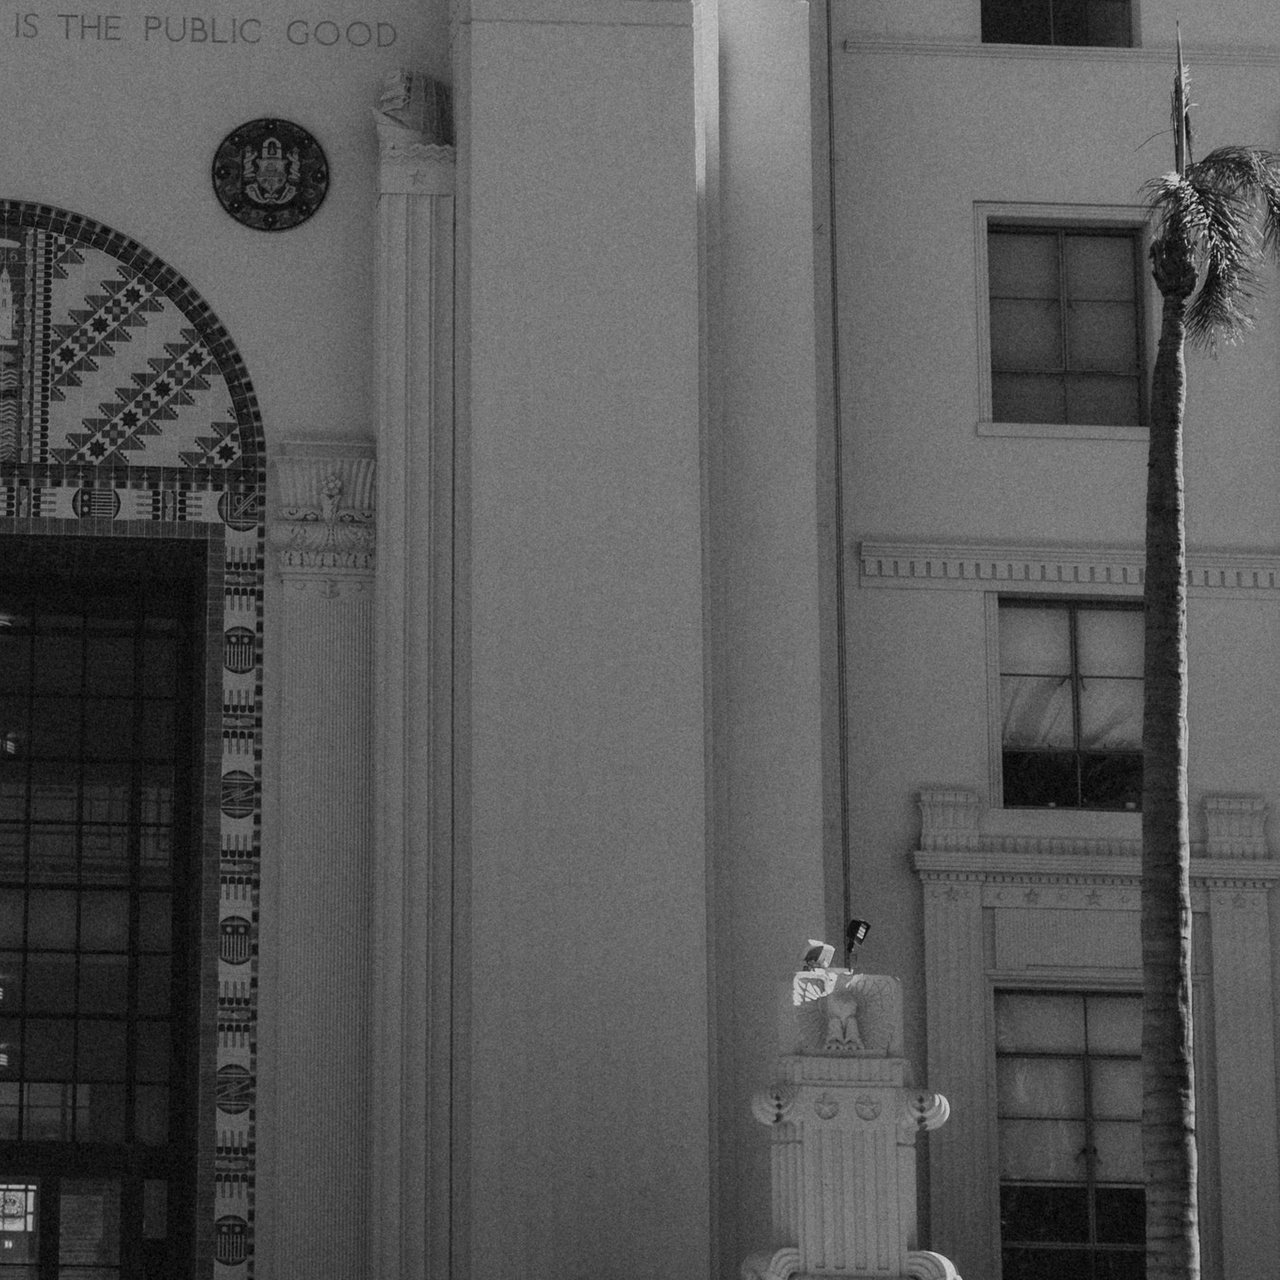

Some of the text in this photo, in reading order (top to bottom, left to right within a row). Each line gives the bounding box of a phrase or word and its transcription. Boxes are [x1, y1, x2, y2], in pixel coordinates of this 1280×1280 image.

[14, 12, 40, 39] IS
[57, 13, 121, 41] THE
[144, 15, 262, 44] PUBLIC
[286, 19, 398, 48] GOOD
